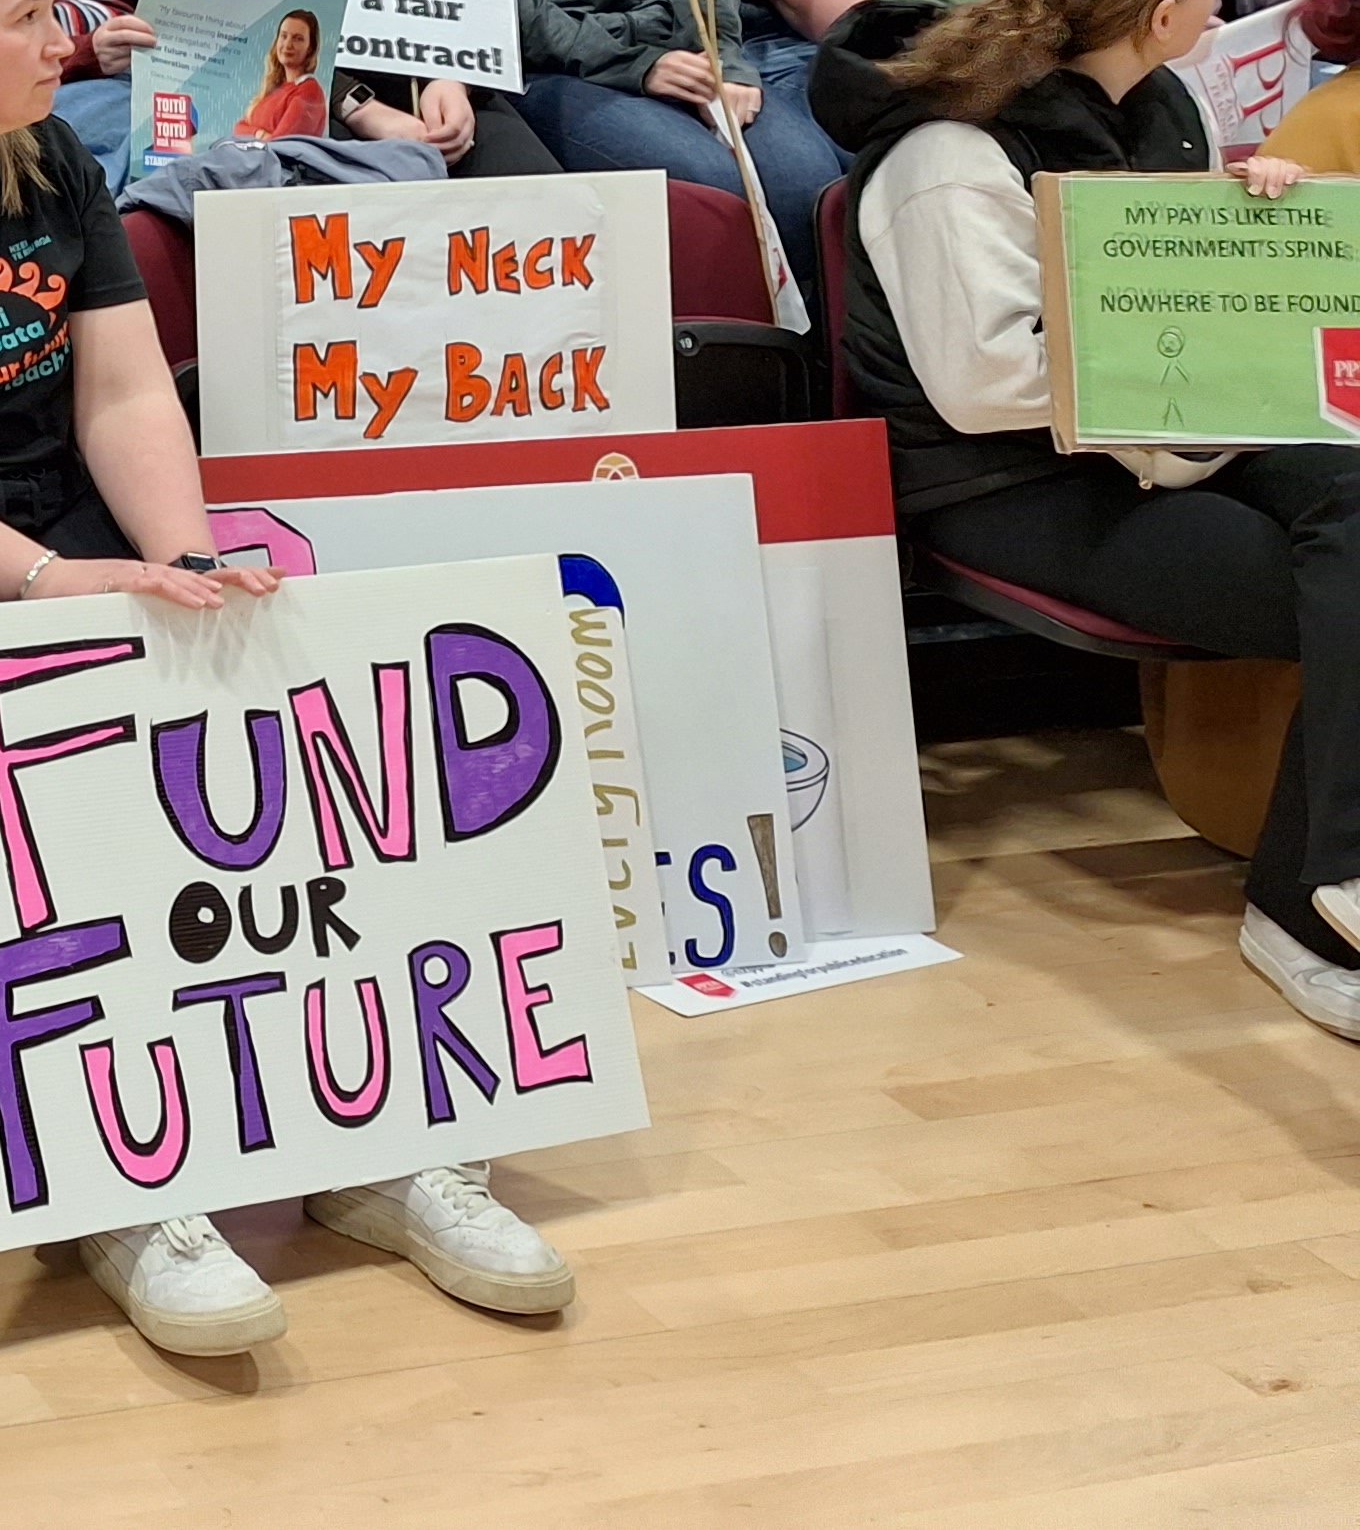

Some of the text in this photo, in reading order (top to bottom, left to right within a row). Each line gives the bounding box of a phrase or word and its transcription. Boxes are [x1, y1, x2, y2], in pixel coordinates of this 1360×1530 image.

[1125, 207, 1326, 227] MY PAY IS LIKE THE
[446, 226, 597, 297] NECK
[1103, 239, 1279, 259] GOVERNMENT'S
[1101, 294, 1212, 313] NOWHERE
[1218, 294, 1248, 313] TO
[1255, 294, 1281, 313] BE
[444, 341, 611, 424] BACK
[167, 875, 364, 965] OUR
